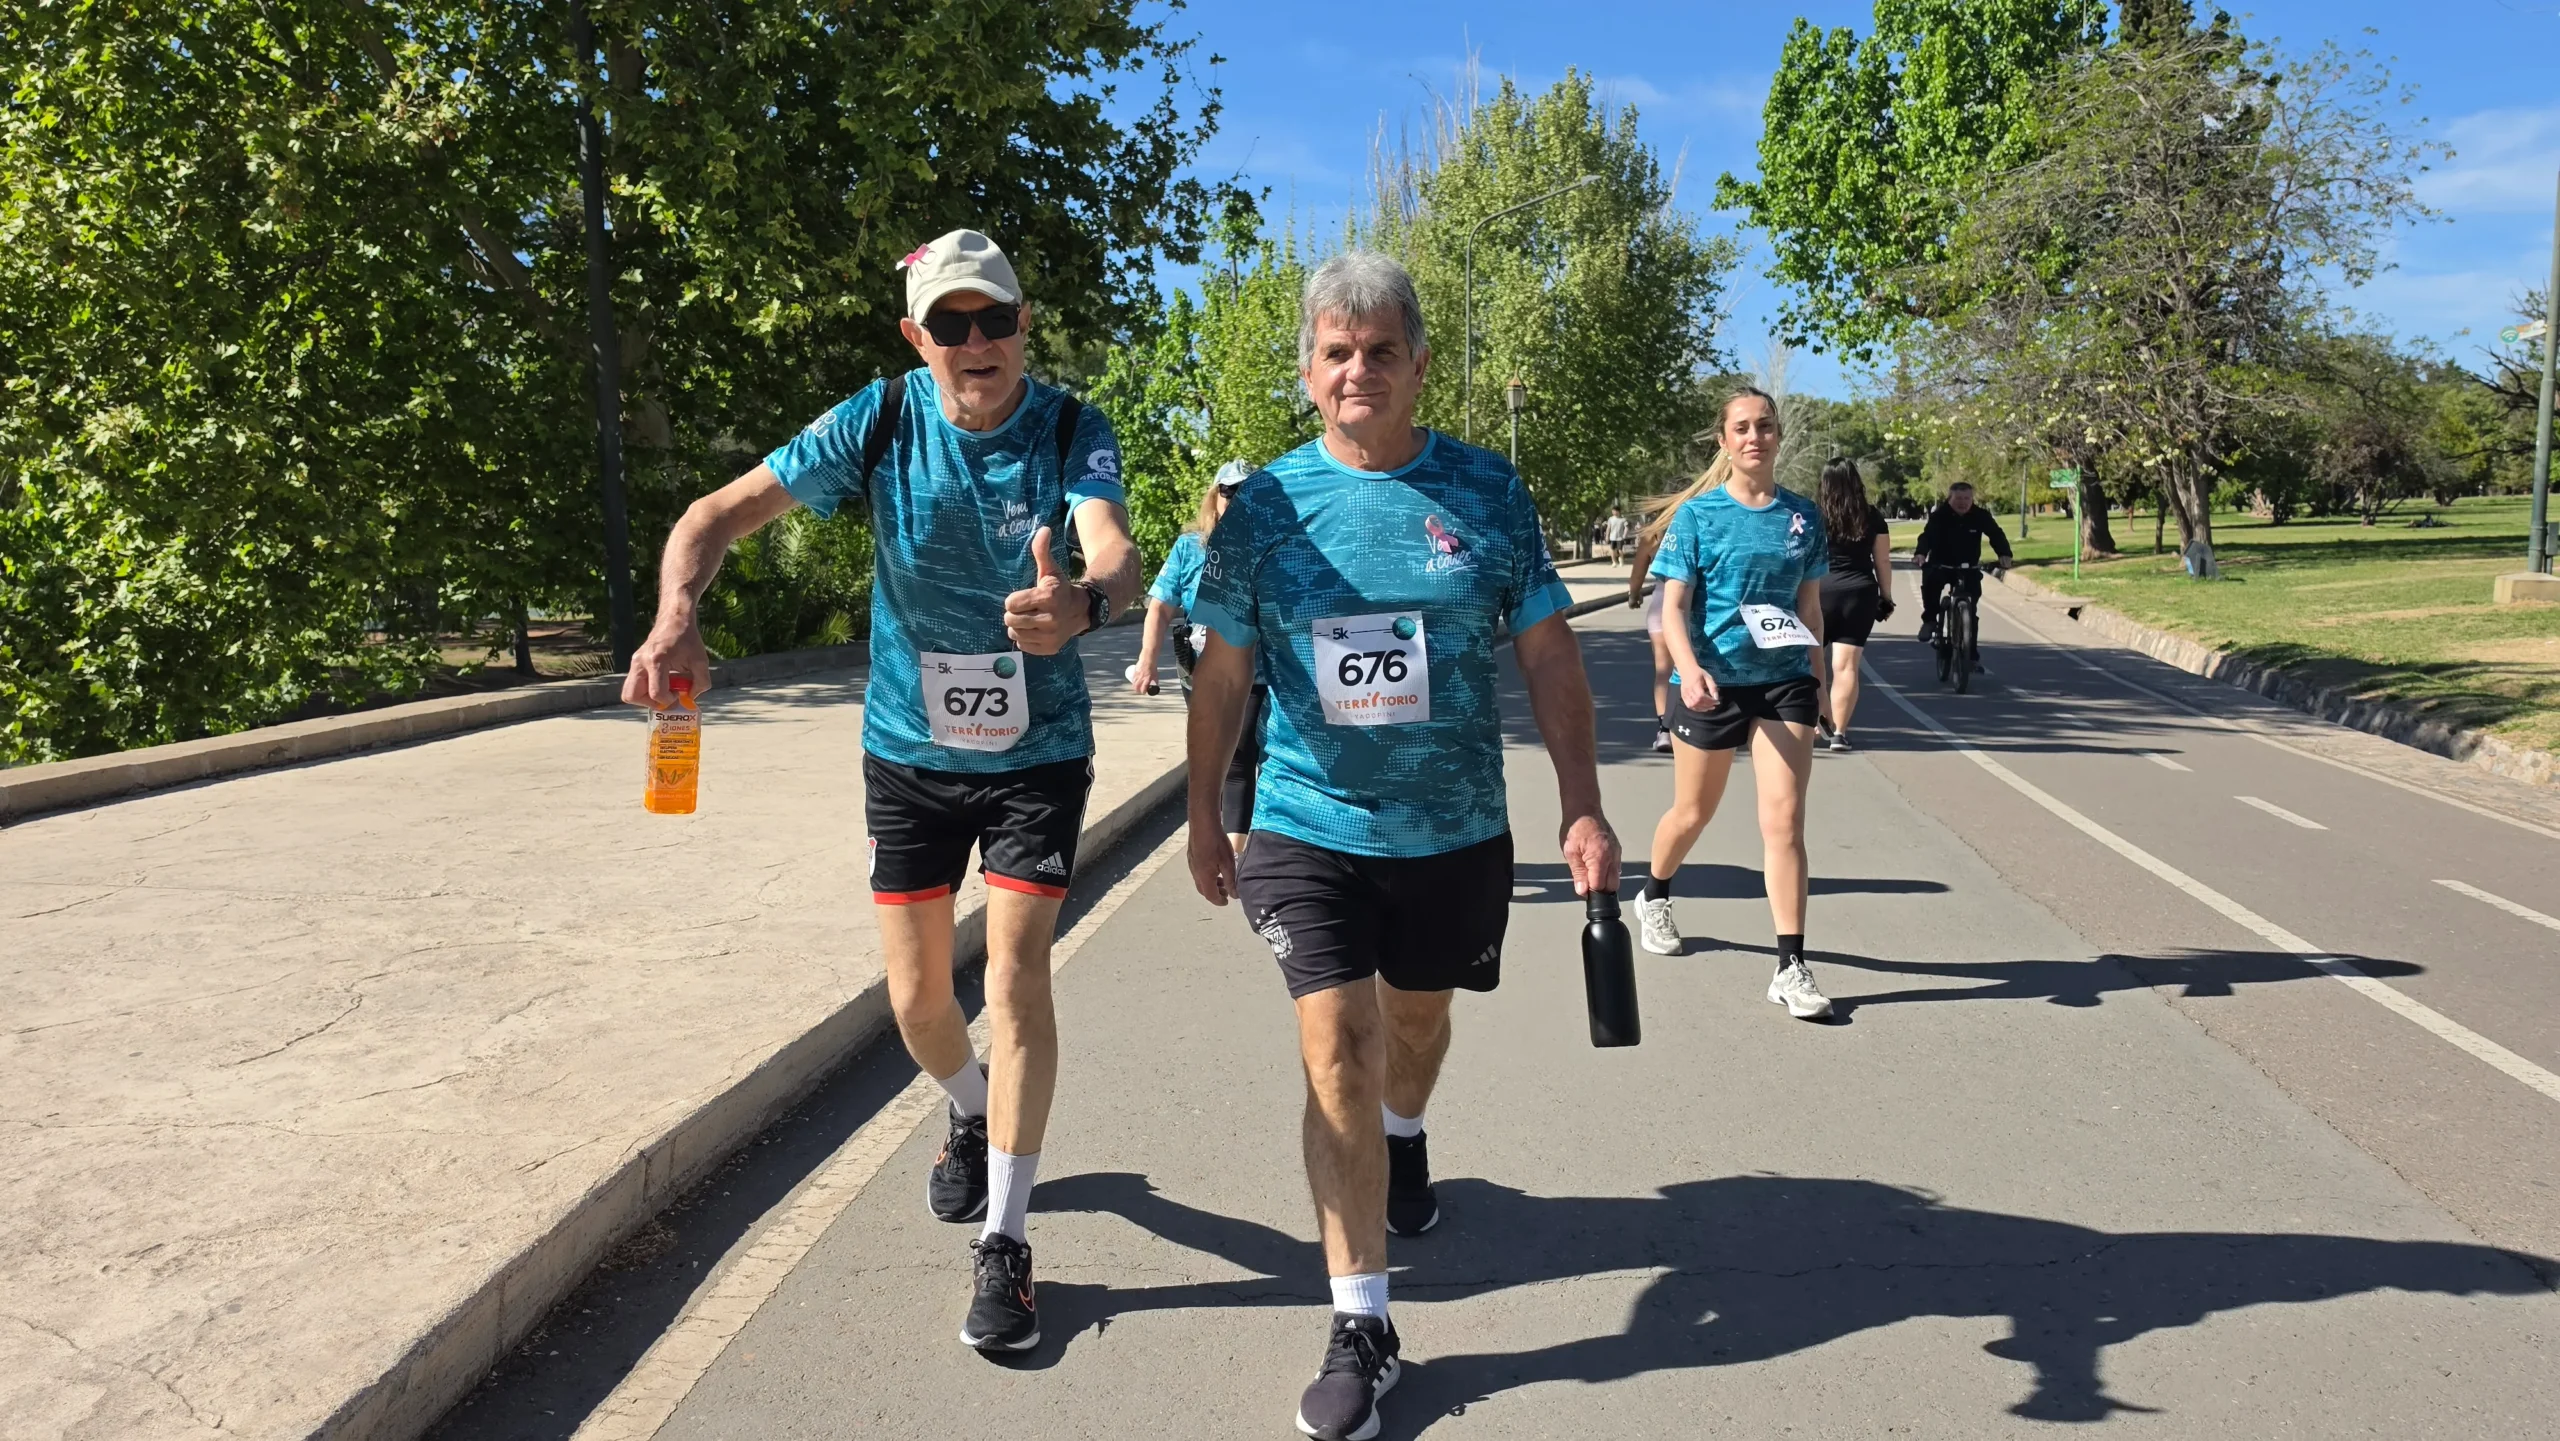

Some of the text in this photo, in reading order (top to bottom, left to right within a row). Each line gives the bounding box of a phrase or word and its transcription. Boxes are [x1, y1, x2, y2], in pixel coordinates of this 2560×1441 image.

[1760, 617, 1798, 632] 674
[1332, 626, 1349, 641] 5k
[938, 662, 953, 675] 5k
[1338, 648, 1408, 687] 676
[944, 687, 1009, 717] 673
[1036, 864, 1067, 876] adidas
